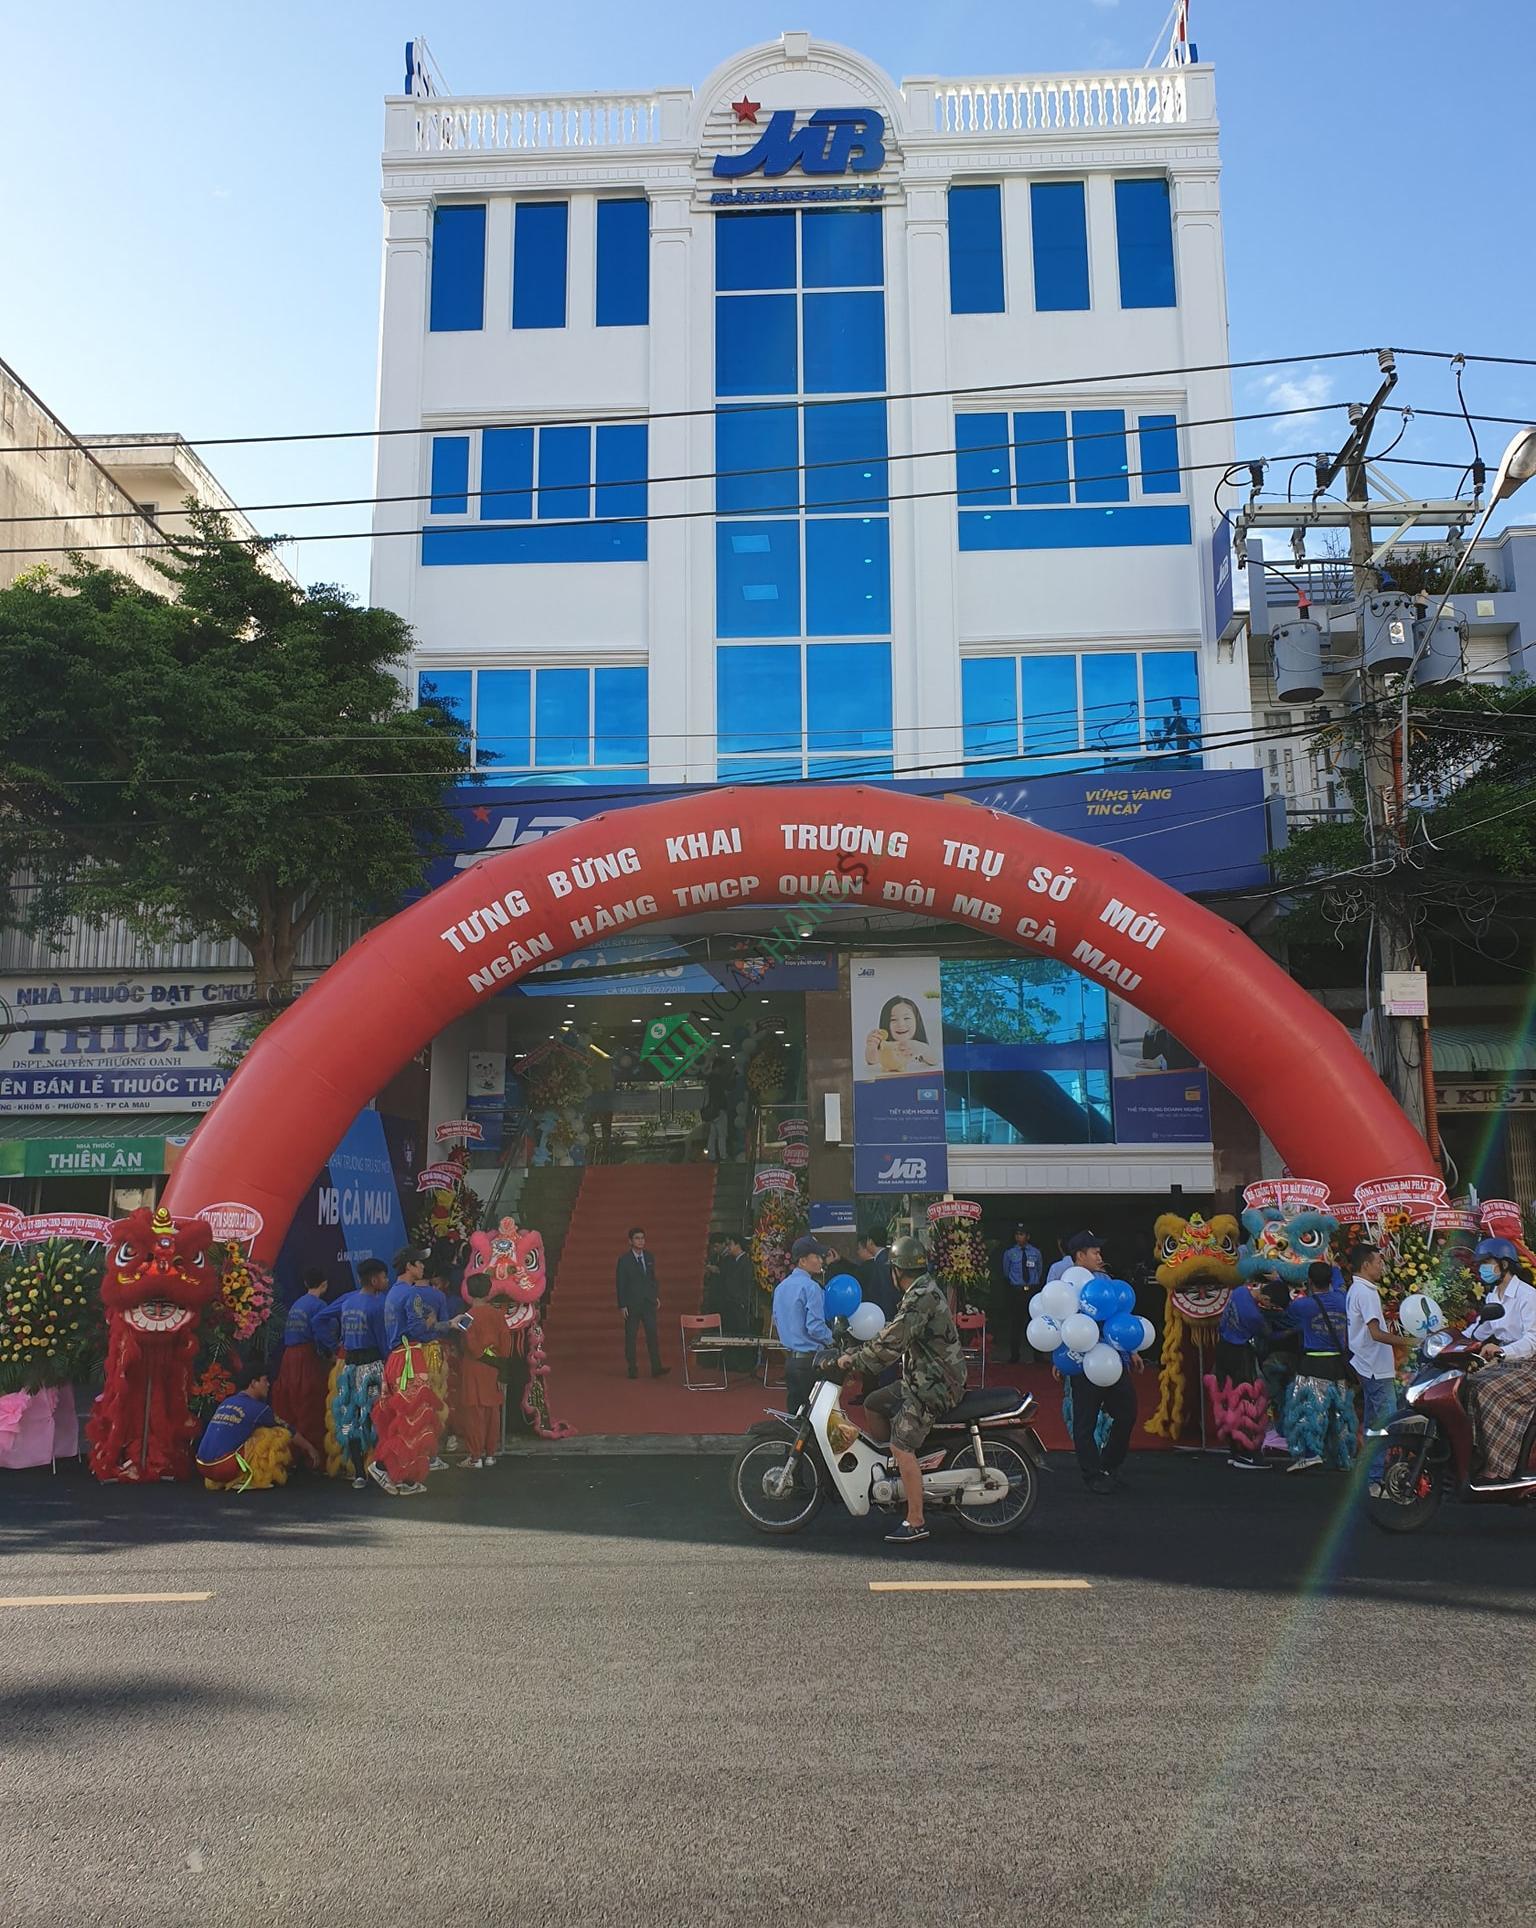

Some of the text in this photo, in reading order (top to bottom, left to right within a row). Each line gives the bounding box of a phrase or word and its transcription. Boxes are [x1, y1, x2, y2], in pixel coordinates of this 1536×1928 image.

[712, 108, 885, 178] MB
[1132, 787, 1172, 800] VÀNG
[440, 822, 1167, 954] TƯNG BỪNG KHAI TRƯƠNG TRỤ SỞ MỚI
[467, 932, 554, 993] NGÂN
[570, 894, 659, 940] HÀNG
[672, 875, 760, 908] TMCP
[778, 870, 864, 896] QUÂN
[882, 879, 936, 907] ĐỘI
[952, 894, 1002, 924] MB
[1016, 918, 1056, 947] CÀ
[1072, 939, 1142, 994] MAU
[17, 983, 62, 1004] NHÀ
[69, 979, 145, 1003] THUỐC
[151, 984, 194, 1006] ĐẠT
[149, 1056, 182, 1067] OANH
[33, 1076, 74, 1095] BÁN
[80, 1074, 104, 1094] LẺ
[111, 1073, 180, 1094] THUỐC
[185, 1074, 231, 1093] THÀ
[132, 1101, 151, 1109] MAU
[49, 1149, 142, 1169] THIÊN ÂN
[878, 1158, 927, 1179] MB
[318, 1179, 392, 1225] MB CÀ MAU
